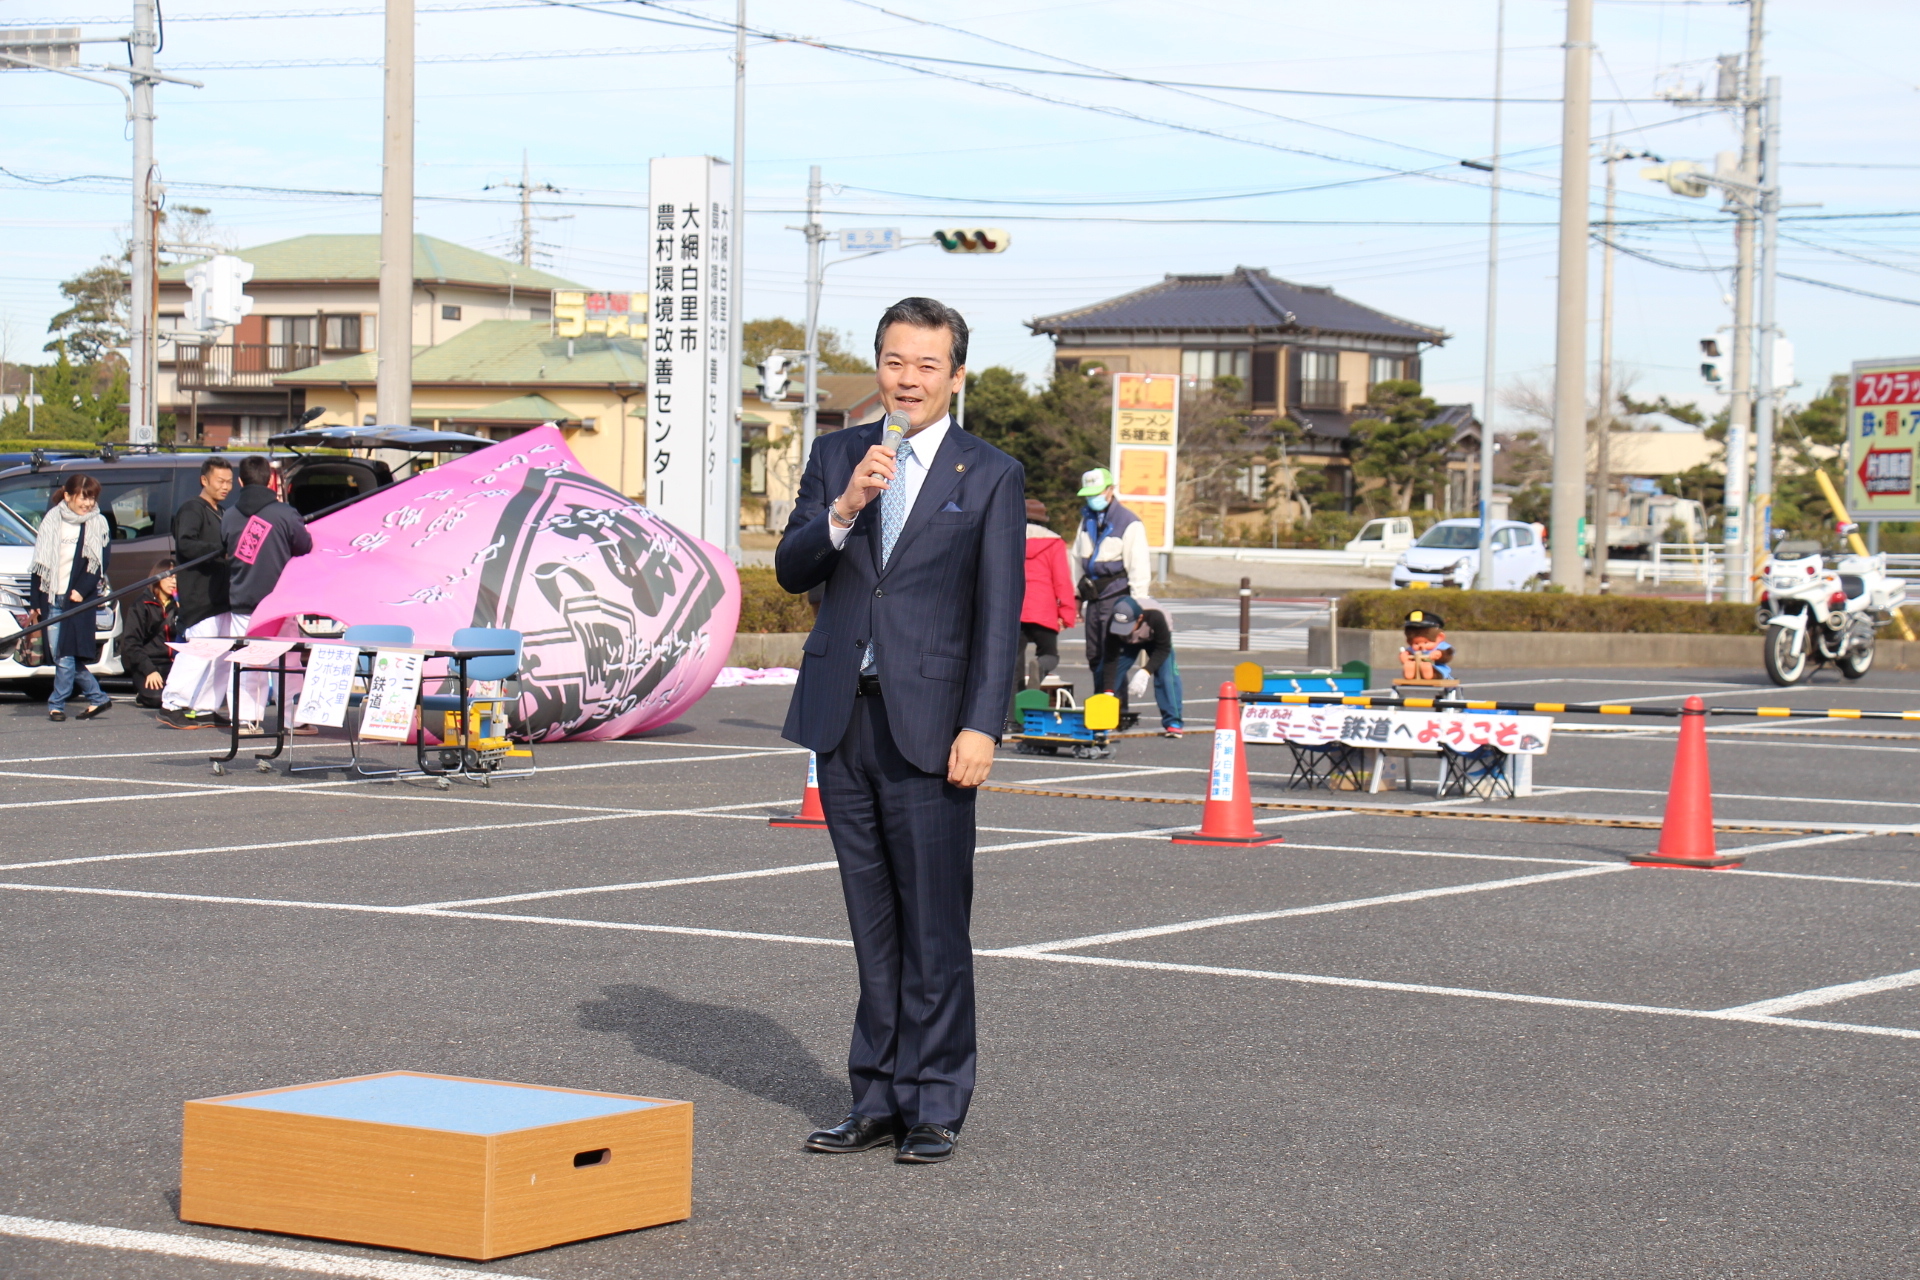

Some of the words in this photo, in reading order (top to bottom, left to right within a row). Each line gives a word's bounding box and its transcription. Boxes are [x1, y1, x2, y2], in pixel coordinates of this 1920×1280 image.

[680, 202, 700, 353] 大網白里市
[654, 203, 675, 505] 農村環境改善センター
[1120, 428, 1171, 442] 各種定食
[1121, 412, 1171, 427] ラーメン
[310, 649, 327, 700] センター
[318, 650, 336, 701] サポート
[321, 650, 345, 723] まちづくり
[334, 649, 354, 704] 大網白里
[369, 676, 387, 710] 鉄道
[1245, 707, 1293, 720] おおあみ
[1222, 732, 1234, 796] 大網白里市
